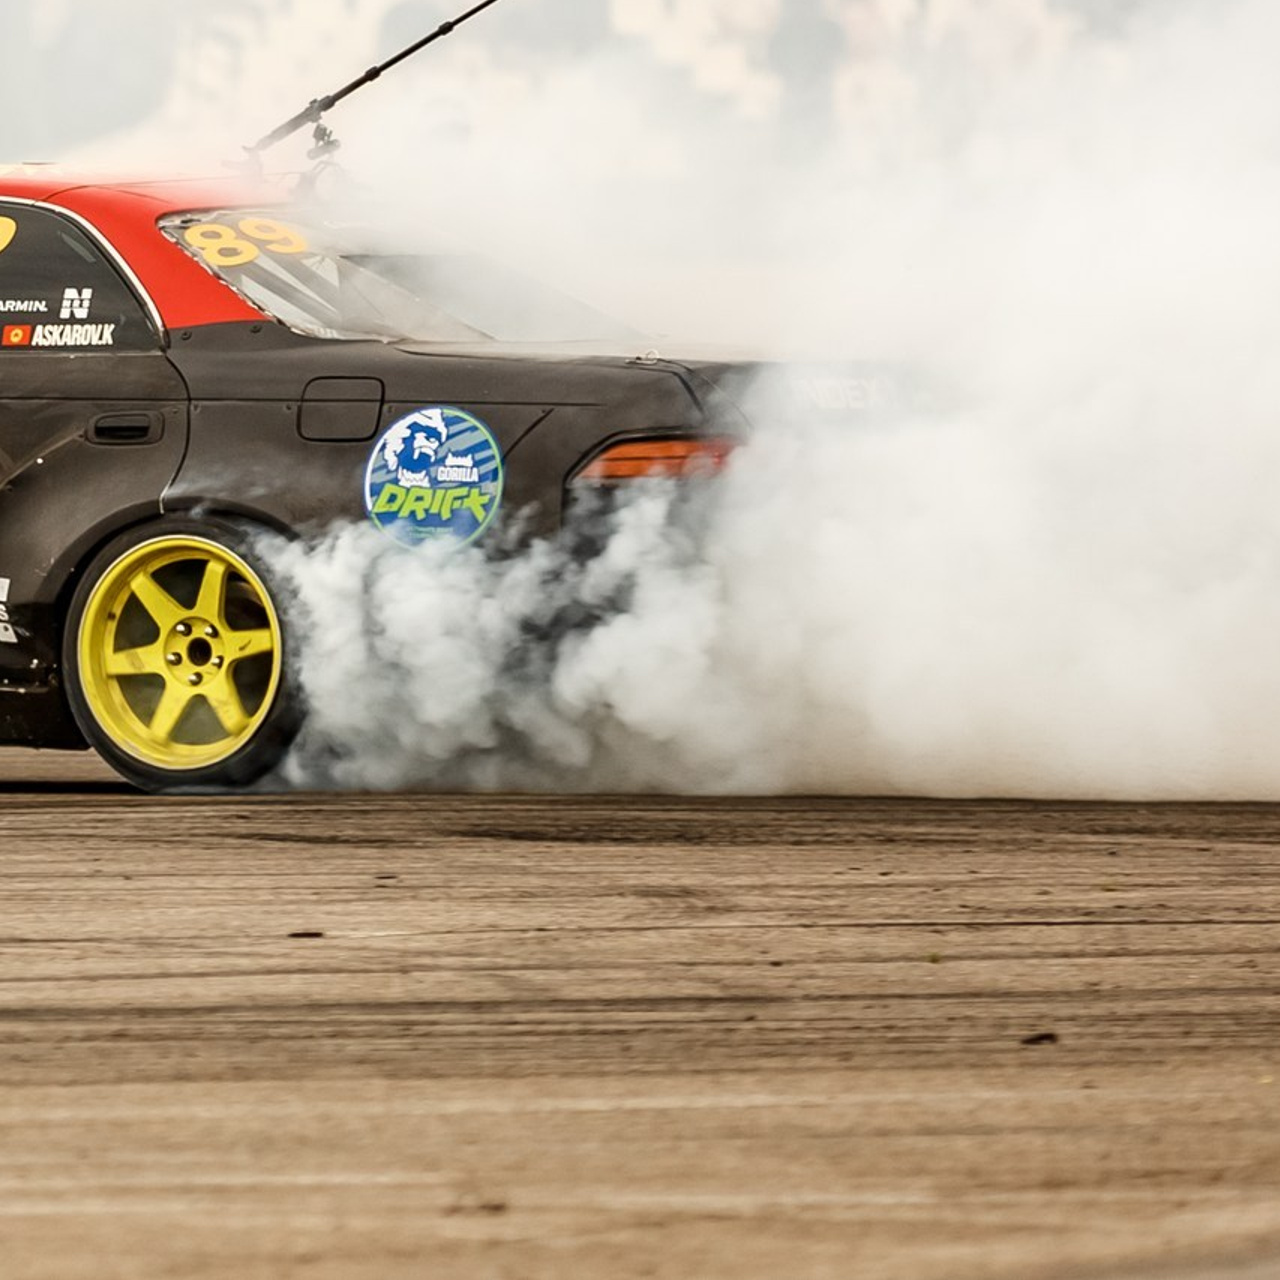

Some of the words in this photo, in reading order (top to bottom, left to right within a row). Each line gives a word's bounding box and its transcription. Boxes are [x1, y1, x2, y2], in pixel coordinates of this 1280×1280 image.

[184, 218, 309, 267] 89
[31, 324, 115, 346] ASKAROV.K
[437, 467, 479, 482] GORILLA
[372, 483, 490, 523] DRIFT
